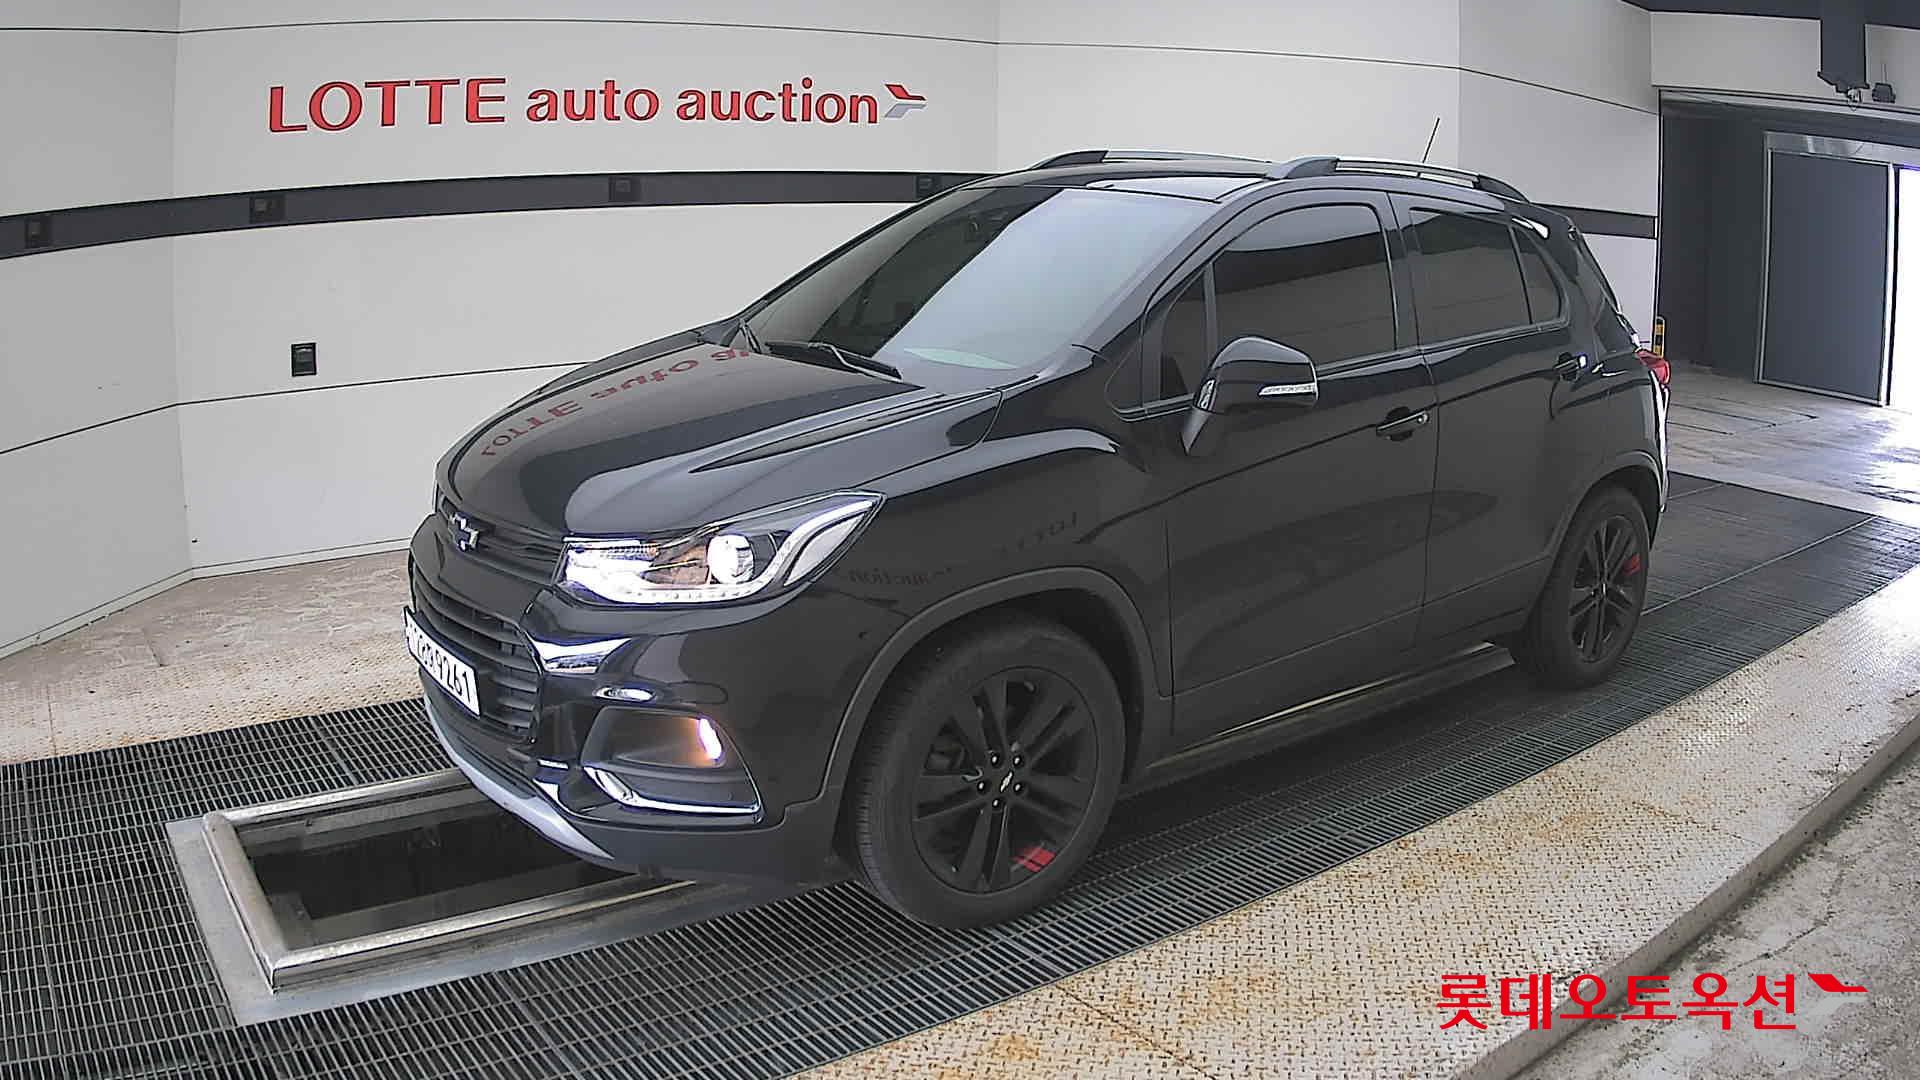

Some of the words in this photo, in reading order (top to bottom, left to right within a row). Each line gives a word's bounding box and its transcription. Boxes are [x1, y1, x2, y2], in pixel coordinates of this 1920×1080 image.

[268, 76, 506, 133] LOTTE
[525, 78, 660, 122] auto
[675, 76, 878, 124] auction
